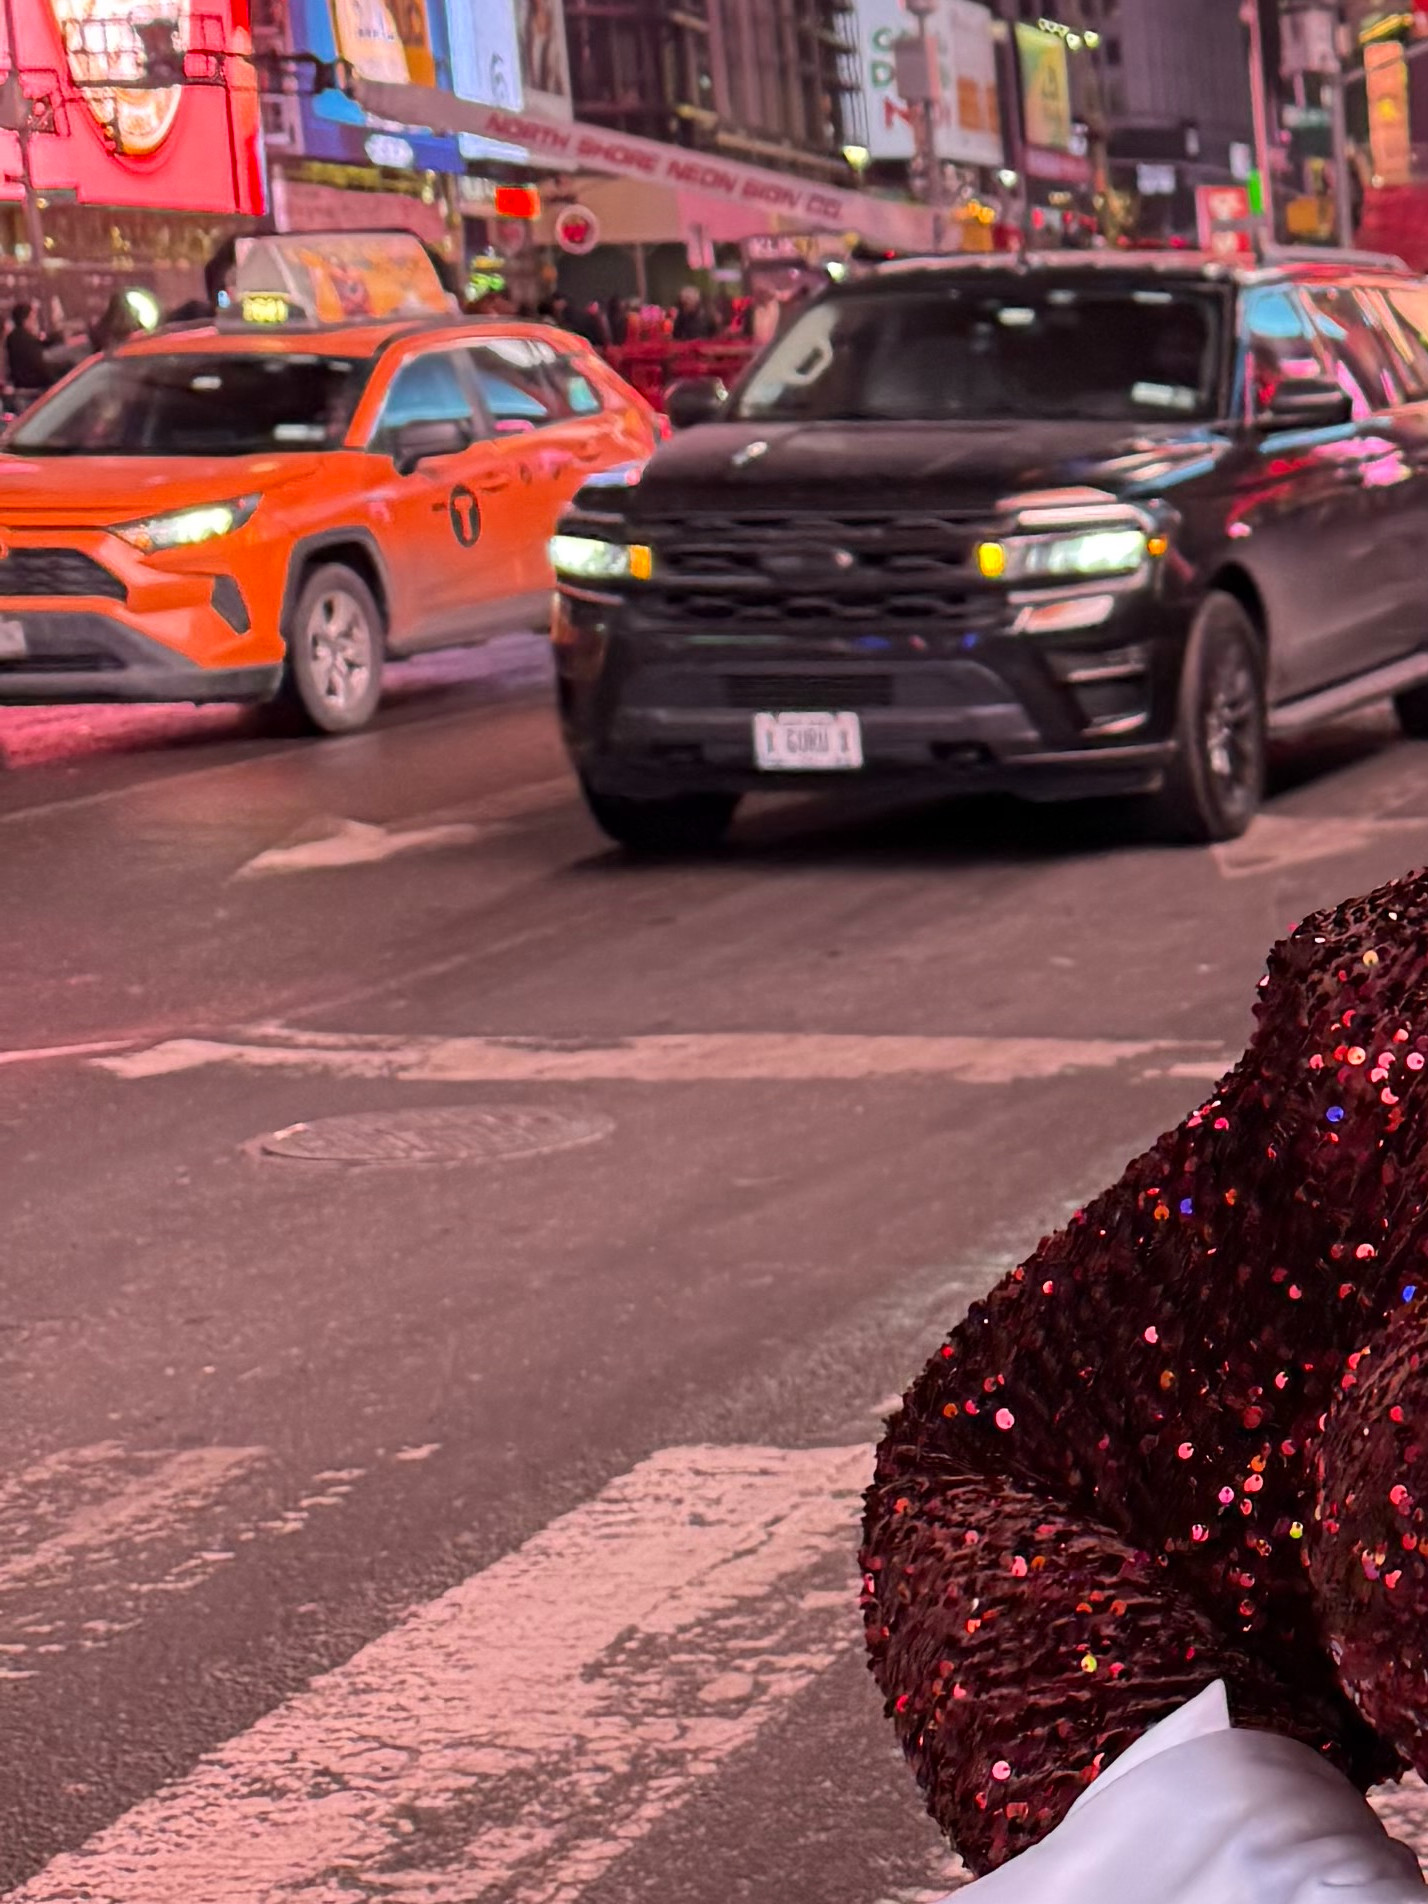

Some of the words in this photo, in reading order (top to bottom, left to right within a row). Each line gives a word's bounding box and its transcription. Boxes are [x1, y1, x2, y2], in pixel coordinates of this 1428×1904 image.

[484, 110, 571, 149] NORTH
[576, 136, 662, 177] SHORE
[665, 157, 739, 195] NEON
